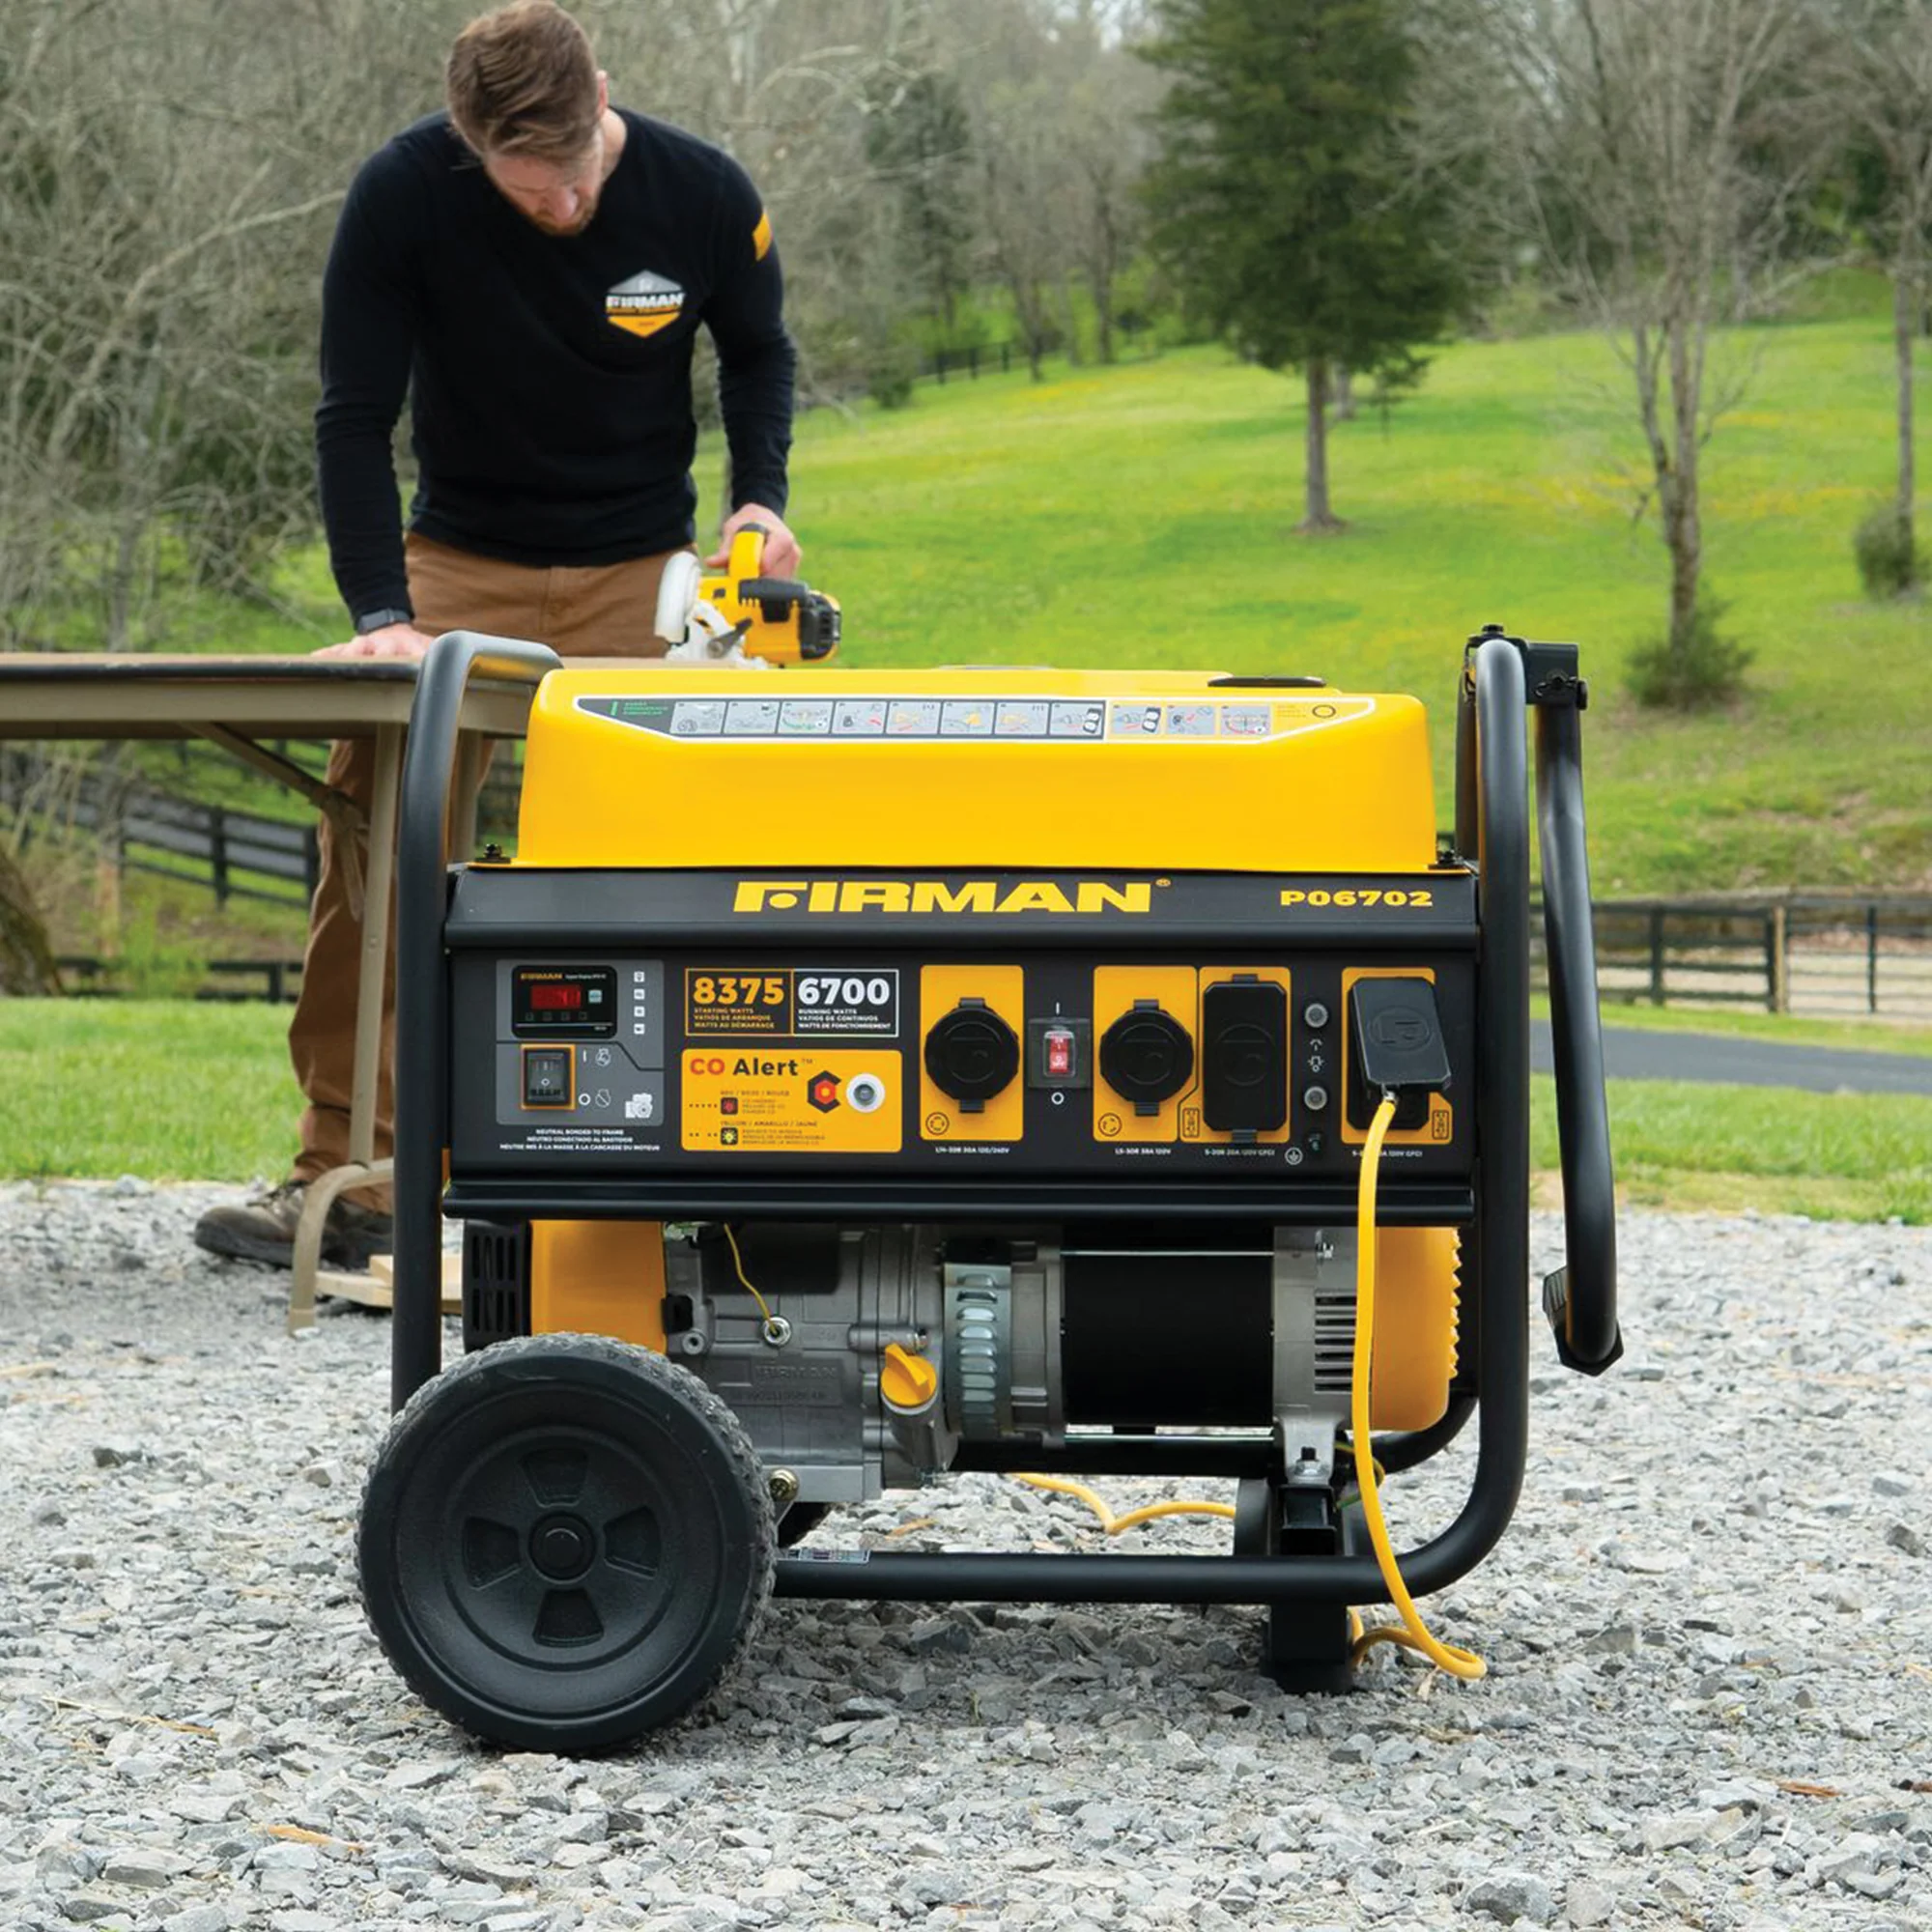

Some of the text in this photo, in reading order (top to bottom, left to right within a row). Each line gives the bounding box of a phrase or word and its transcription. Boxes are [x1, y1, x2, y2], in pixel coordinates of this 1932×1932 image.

[606, 292, 686, 308] FIRMAN
[733, 881, 1151, 914] FIRMAN
[1280, 890, 1435, 909] P06702
[693, 977, 785, 1006] 8375
[797, 977, 891, 1006] 6700
[690, 1058, 725, 1076] CO
